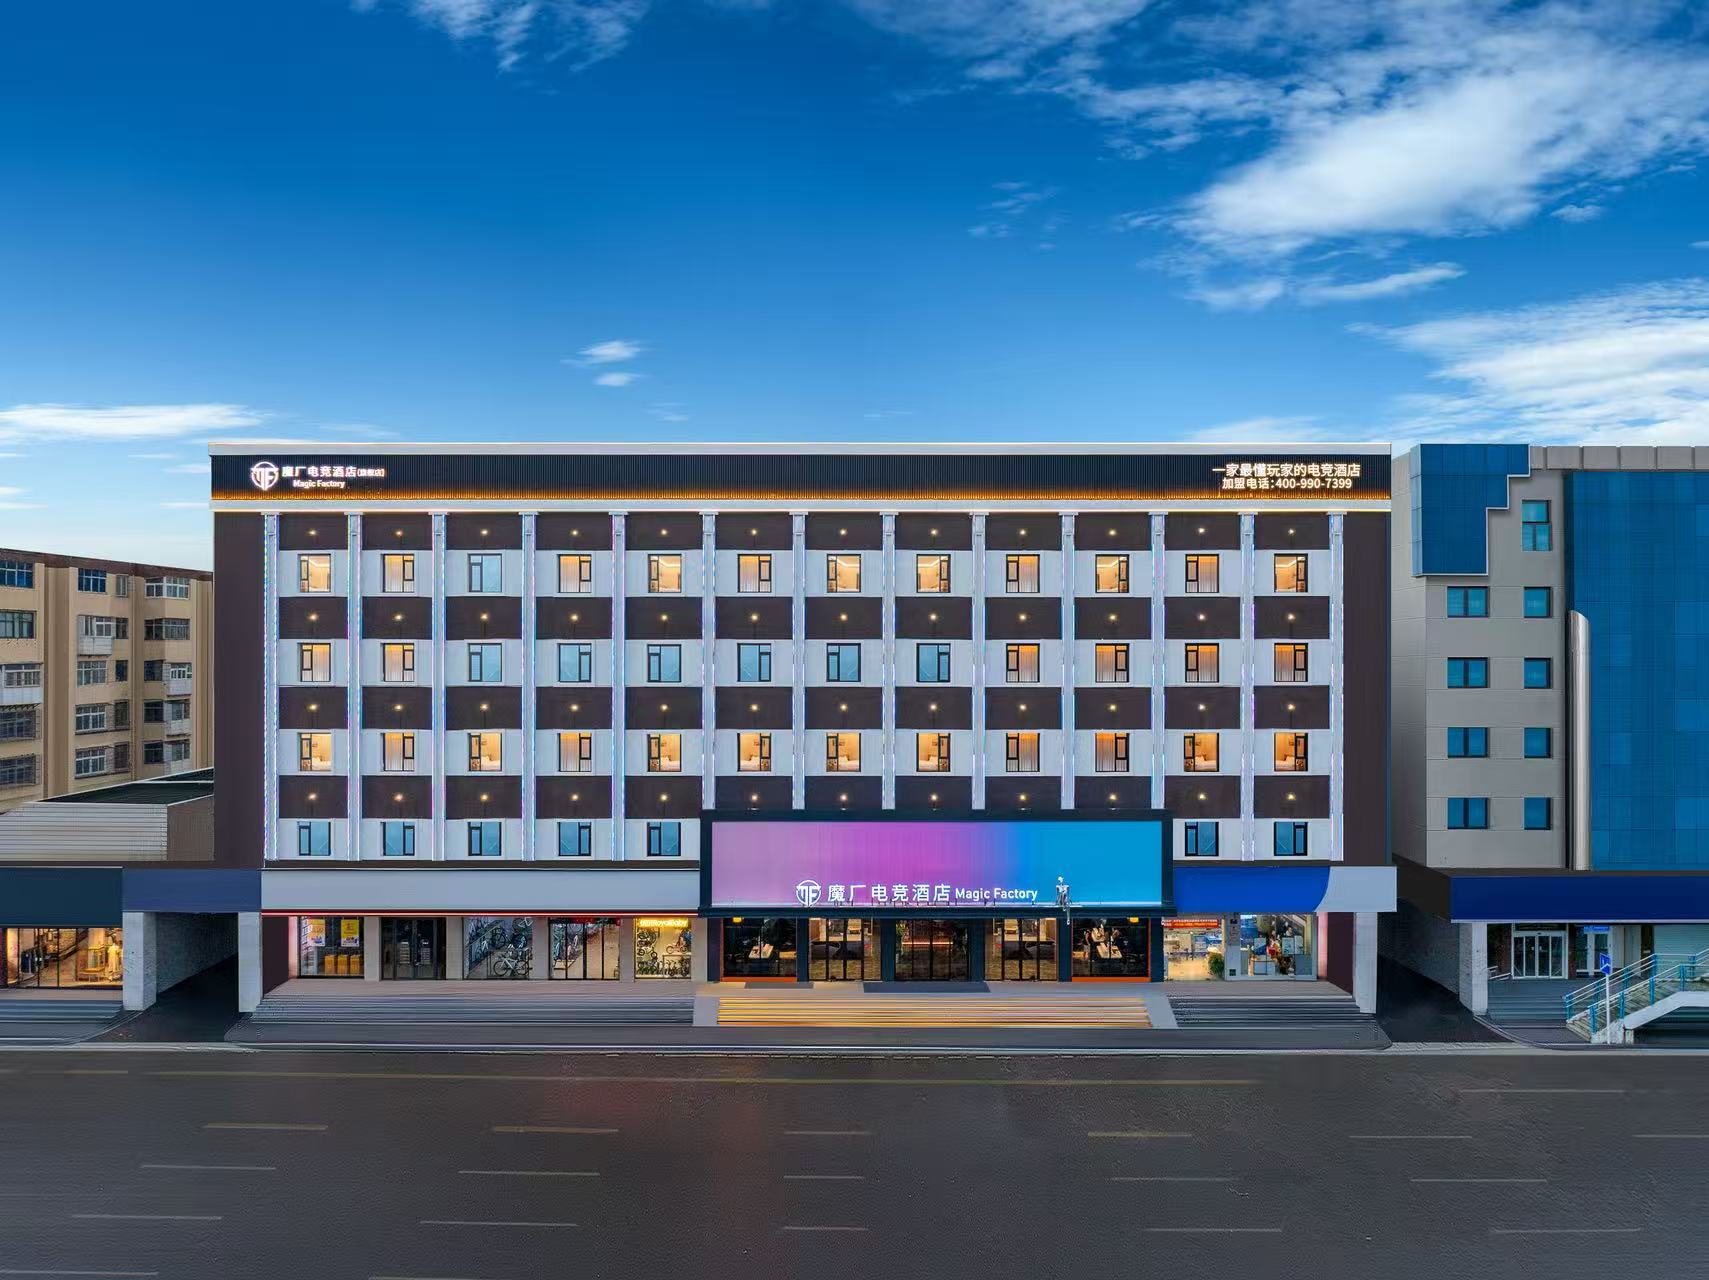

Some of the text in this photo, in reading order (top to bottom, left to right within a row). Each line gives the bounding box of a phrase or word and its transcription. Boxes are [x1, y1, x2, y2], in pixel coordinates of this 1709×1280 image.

[1212, 462, 1361, 477] 一家最懂玩家的电竞酒店
[292, 480, 346, 489] Magic Factory
[827, 883, 1038, 903] 魔厂电竞酒店 Magic Factory
